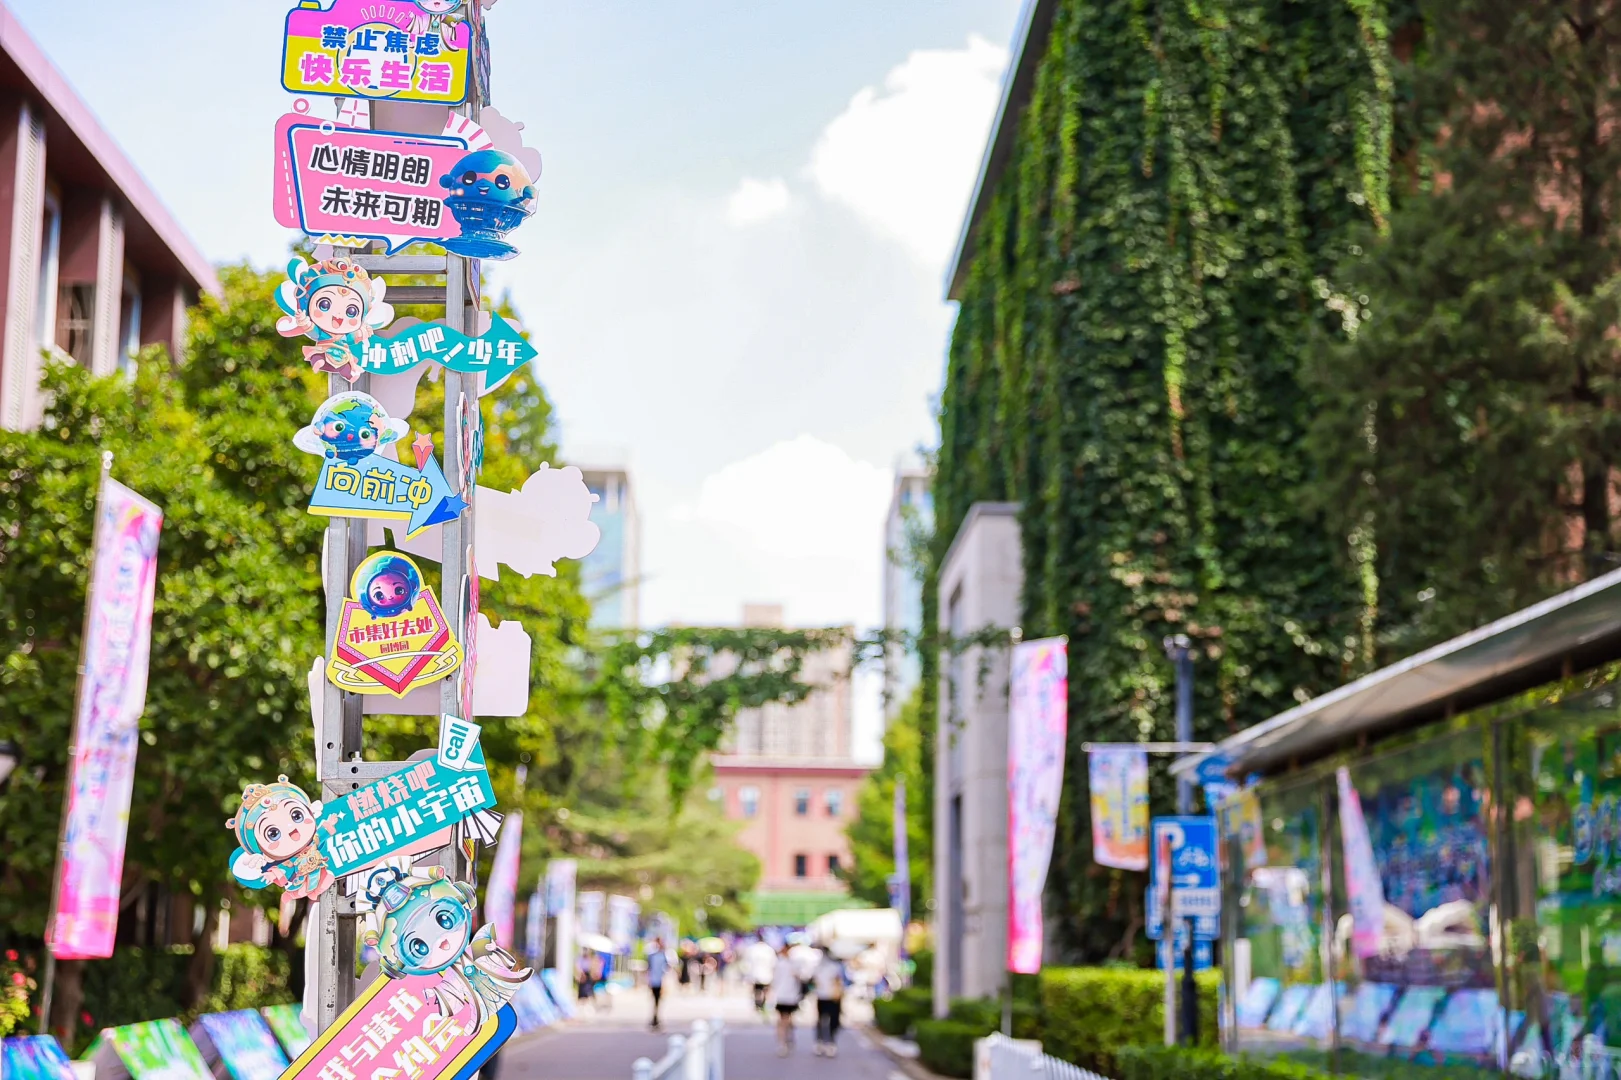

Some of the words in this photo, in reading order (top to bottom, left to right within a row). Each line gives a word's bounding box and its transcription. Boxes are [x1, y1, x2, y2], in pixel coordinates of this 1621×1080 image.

[321, 26, 440, 55] 禁止焦虑
[300, 54, 450, 92] 快乐生活
[310, 145, 430, 184] 心情明朗
[321, 187, 441, 227] 未来可期
[325, 462, 432, 508] 向前冲
[348, 616, 433, 643] 市集好去处
[445, 722, 469, 761] call
[347, 760, 440, 822] 燃烧吧
[327, 775, 485, 868] 你的小宇宙
